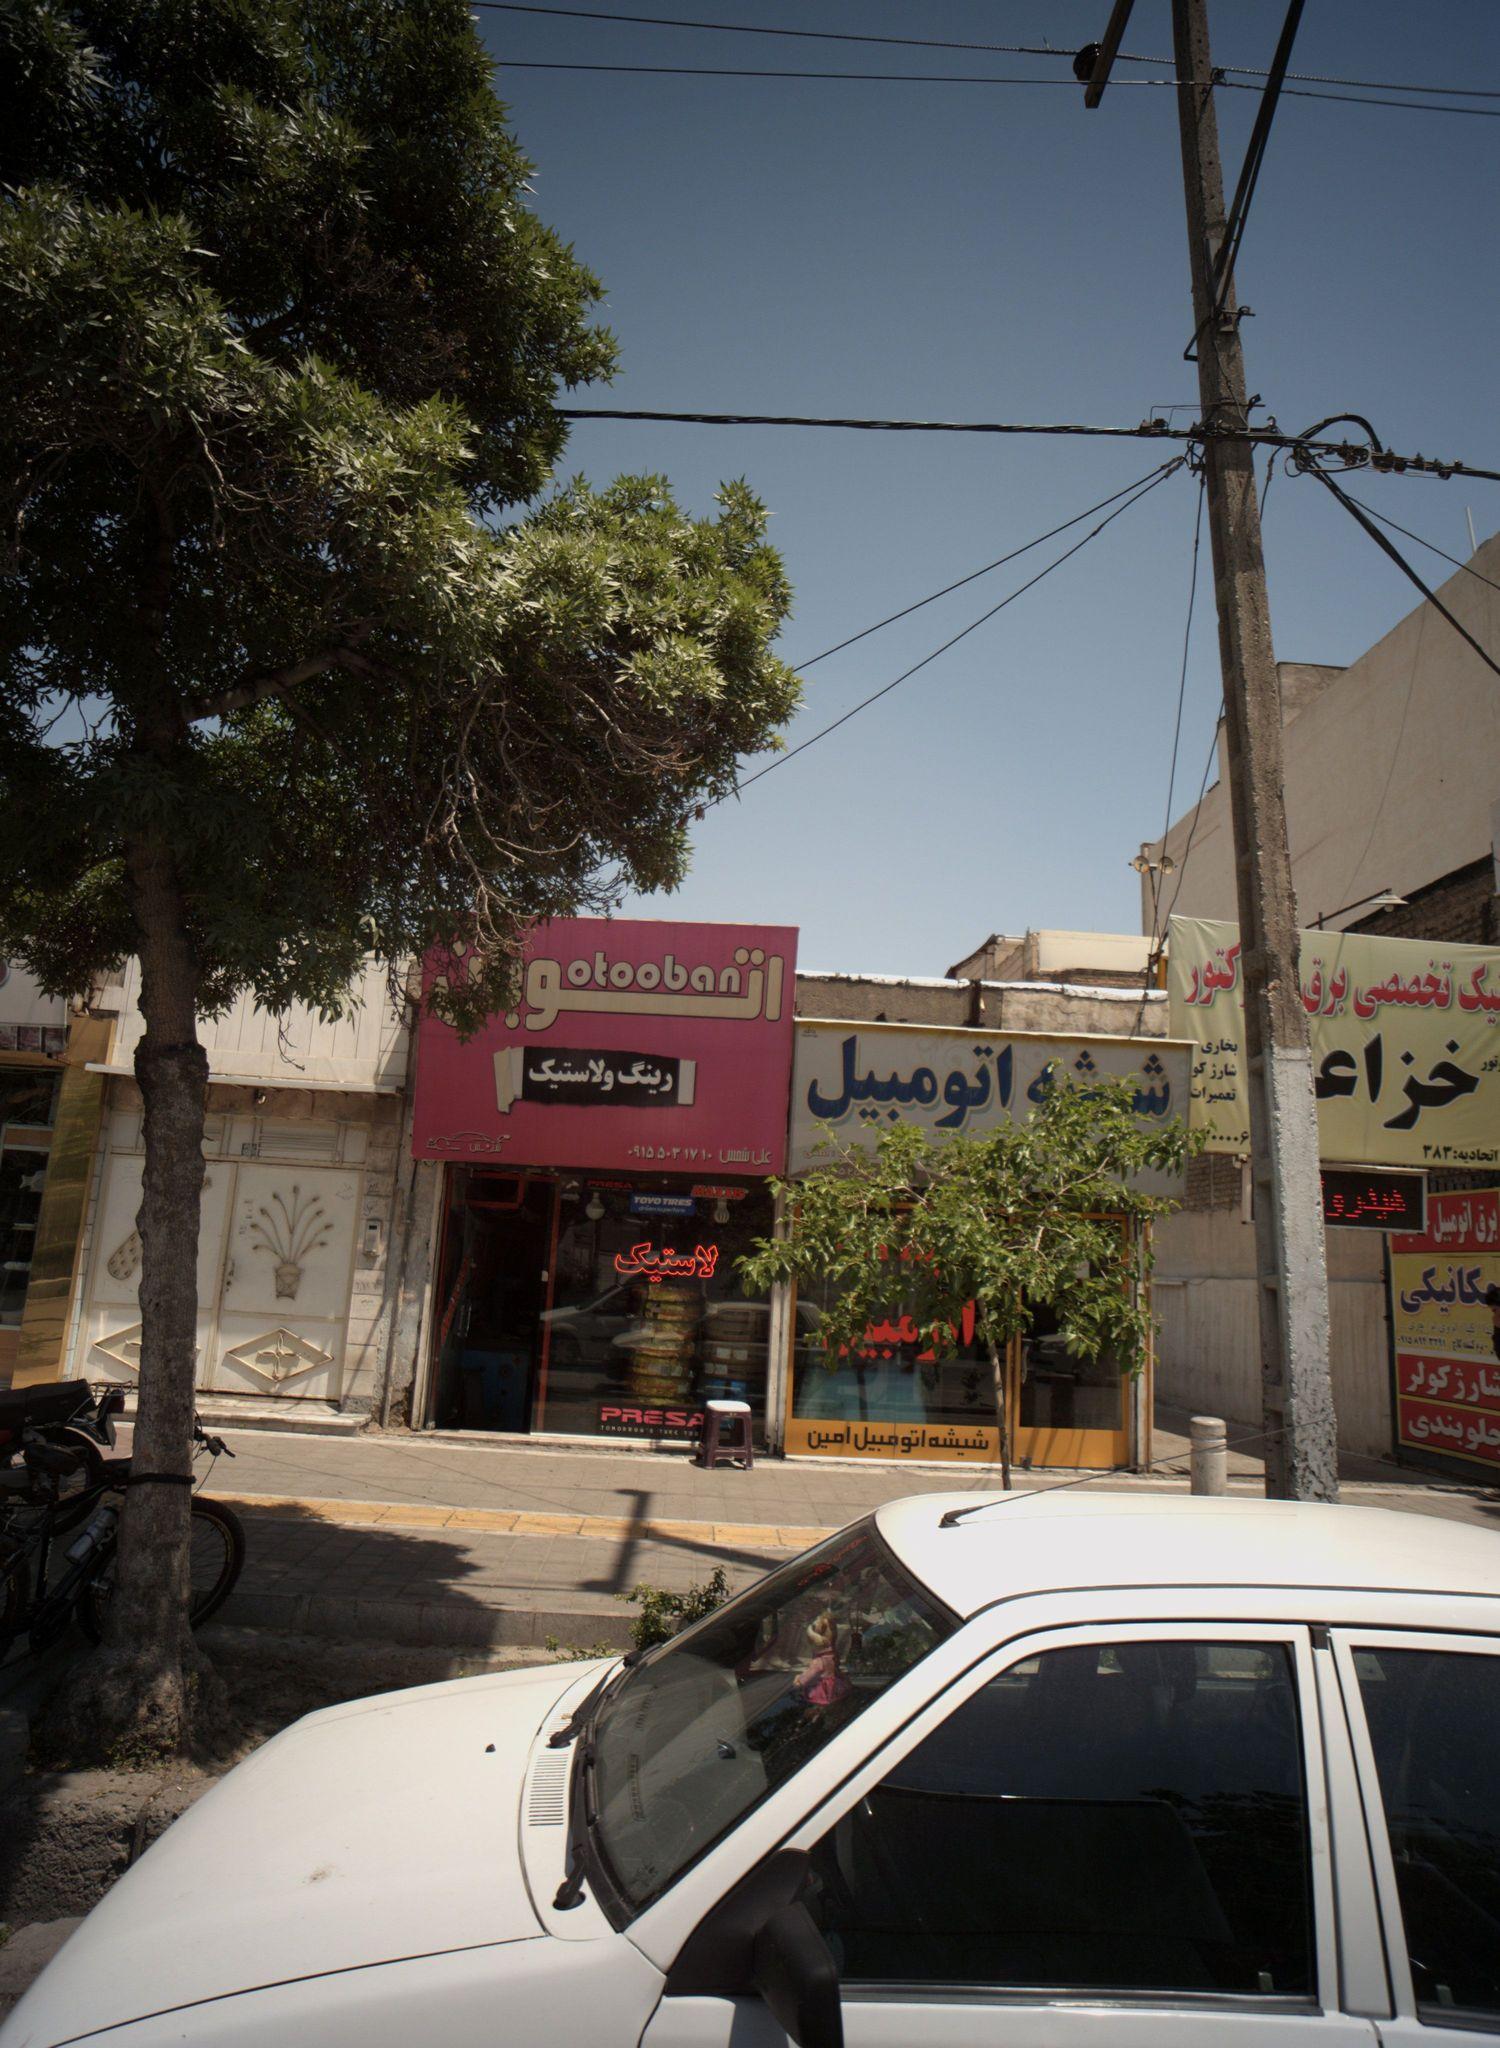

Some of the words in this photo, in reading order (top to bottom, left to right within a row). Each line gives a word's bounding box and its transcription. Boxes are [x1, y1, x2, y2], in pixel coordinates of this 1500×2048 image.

[434, 940, 784, 1031] اتو
[567, 951, 742, 994] otooban
[1301, 958, 1348, 1017] برق
[1353, 960, 1453, 1019] تخصصی
[1201, 1038, 1238, 1057] بخاری
[618, 1060, 673, 1093] رینگ
[807, 1034, 1013, 1128] اتومبیل
[1210, 1063, 1237, 1080] شارژ
[1314, 1032, 1480, 1130] خزاع
[1190, 1086, 1237, 1103] تعمیرات
[633, 1196, 661, 1205] TOYO
[662, 1198, 693, 1207] TIRES
[1434, 1199, 1472, 1244] اتومبیل
[1475, 1203, 1498, 1243] برق
[614, 1241, 719, 1283] لاستیک
[1406, 1361, 1451, 1395] کولر
[601, 1406, 704, 1427] PRESA
[807, 1424, 851, 1449] امین
[854, 1425, 925, 1453] اتومبیل
[928, 1429, 989, 1456] شیشه
